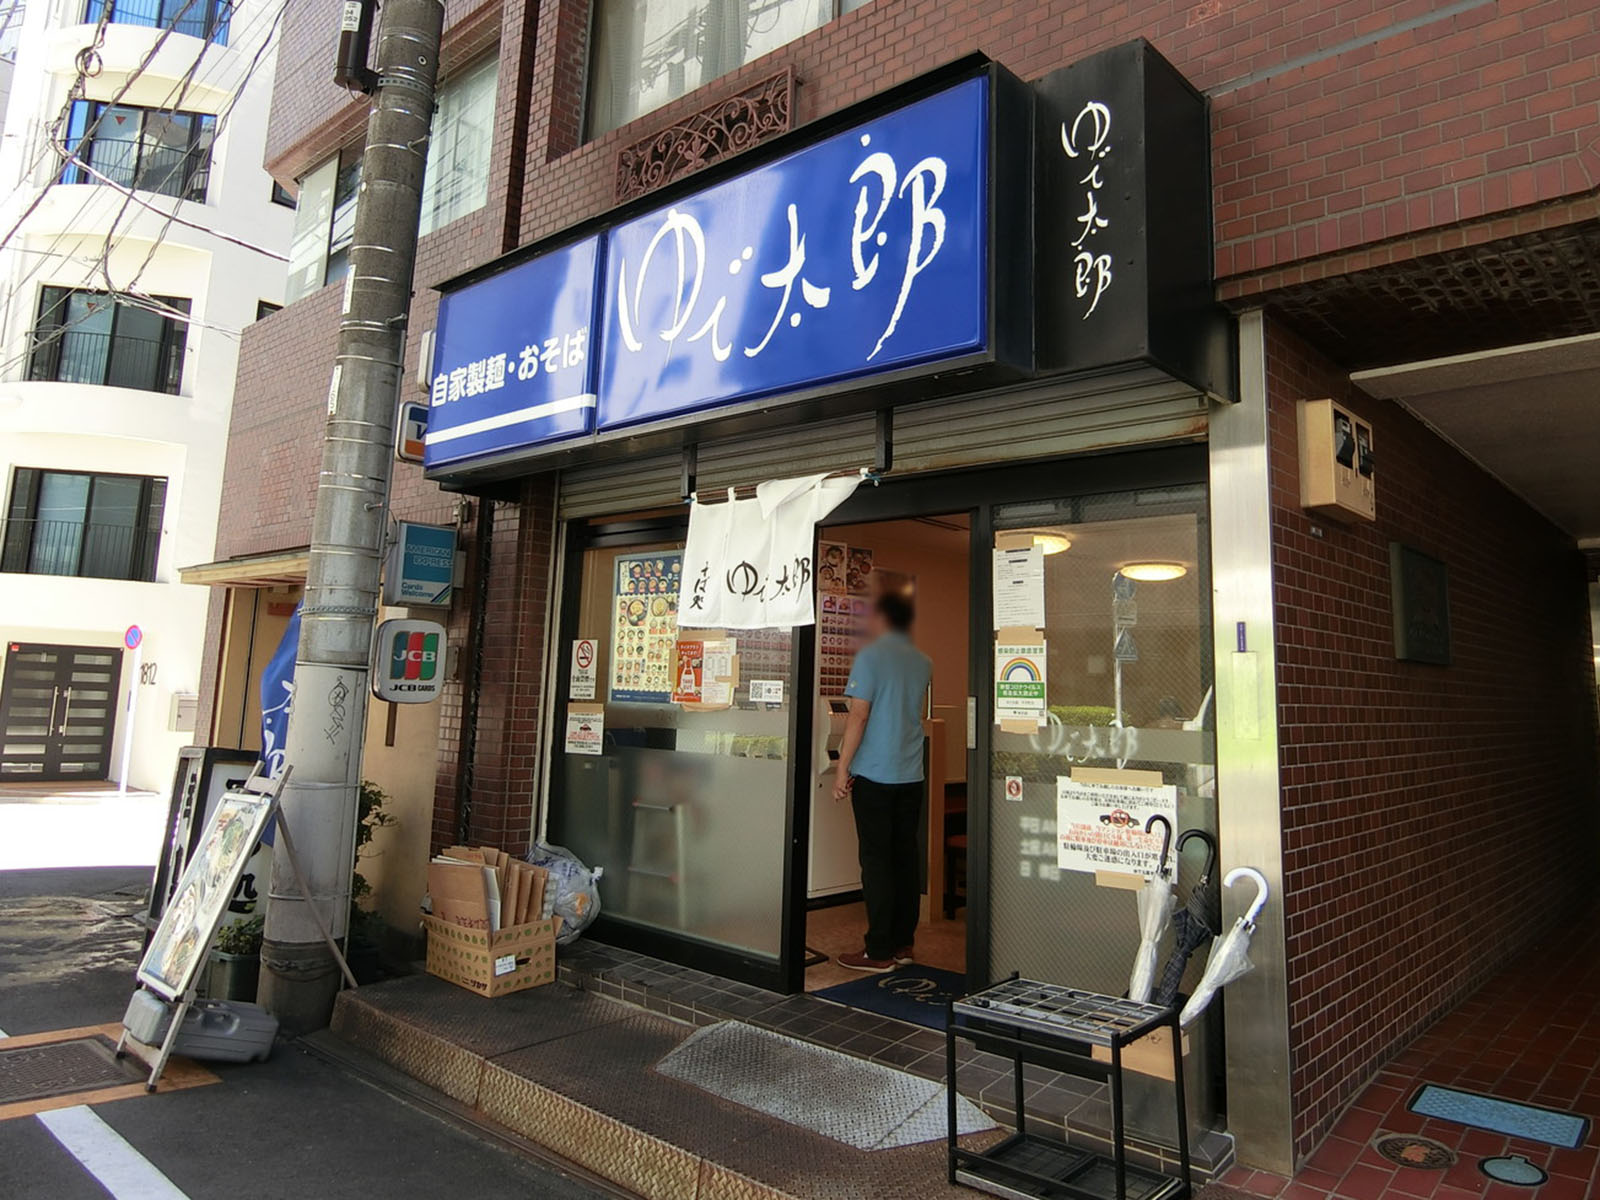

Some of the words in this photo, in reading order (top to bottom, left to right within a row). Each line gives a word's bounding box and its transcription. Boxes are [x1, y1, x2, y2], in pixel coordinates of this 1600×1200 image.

[1060, 100, 1113, 321] ゆで太郎
[617, 133, 948, 367] ゆで太郎
[431, 326, 588, 408] 自家製麺・おそば
[401, 581, 424, 591] Cards
[401, 588, 435, 599] Welcome
[726, 554, 811, 605] ゆで太郎
[393, 649, 437, 662] JCB
[389, 683, 417, 692] JCB
[417, 683, 436, 693] CARDS
